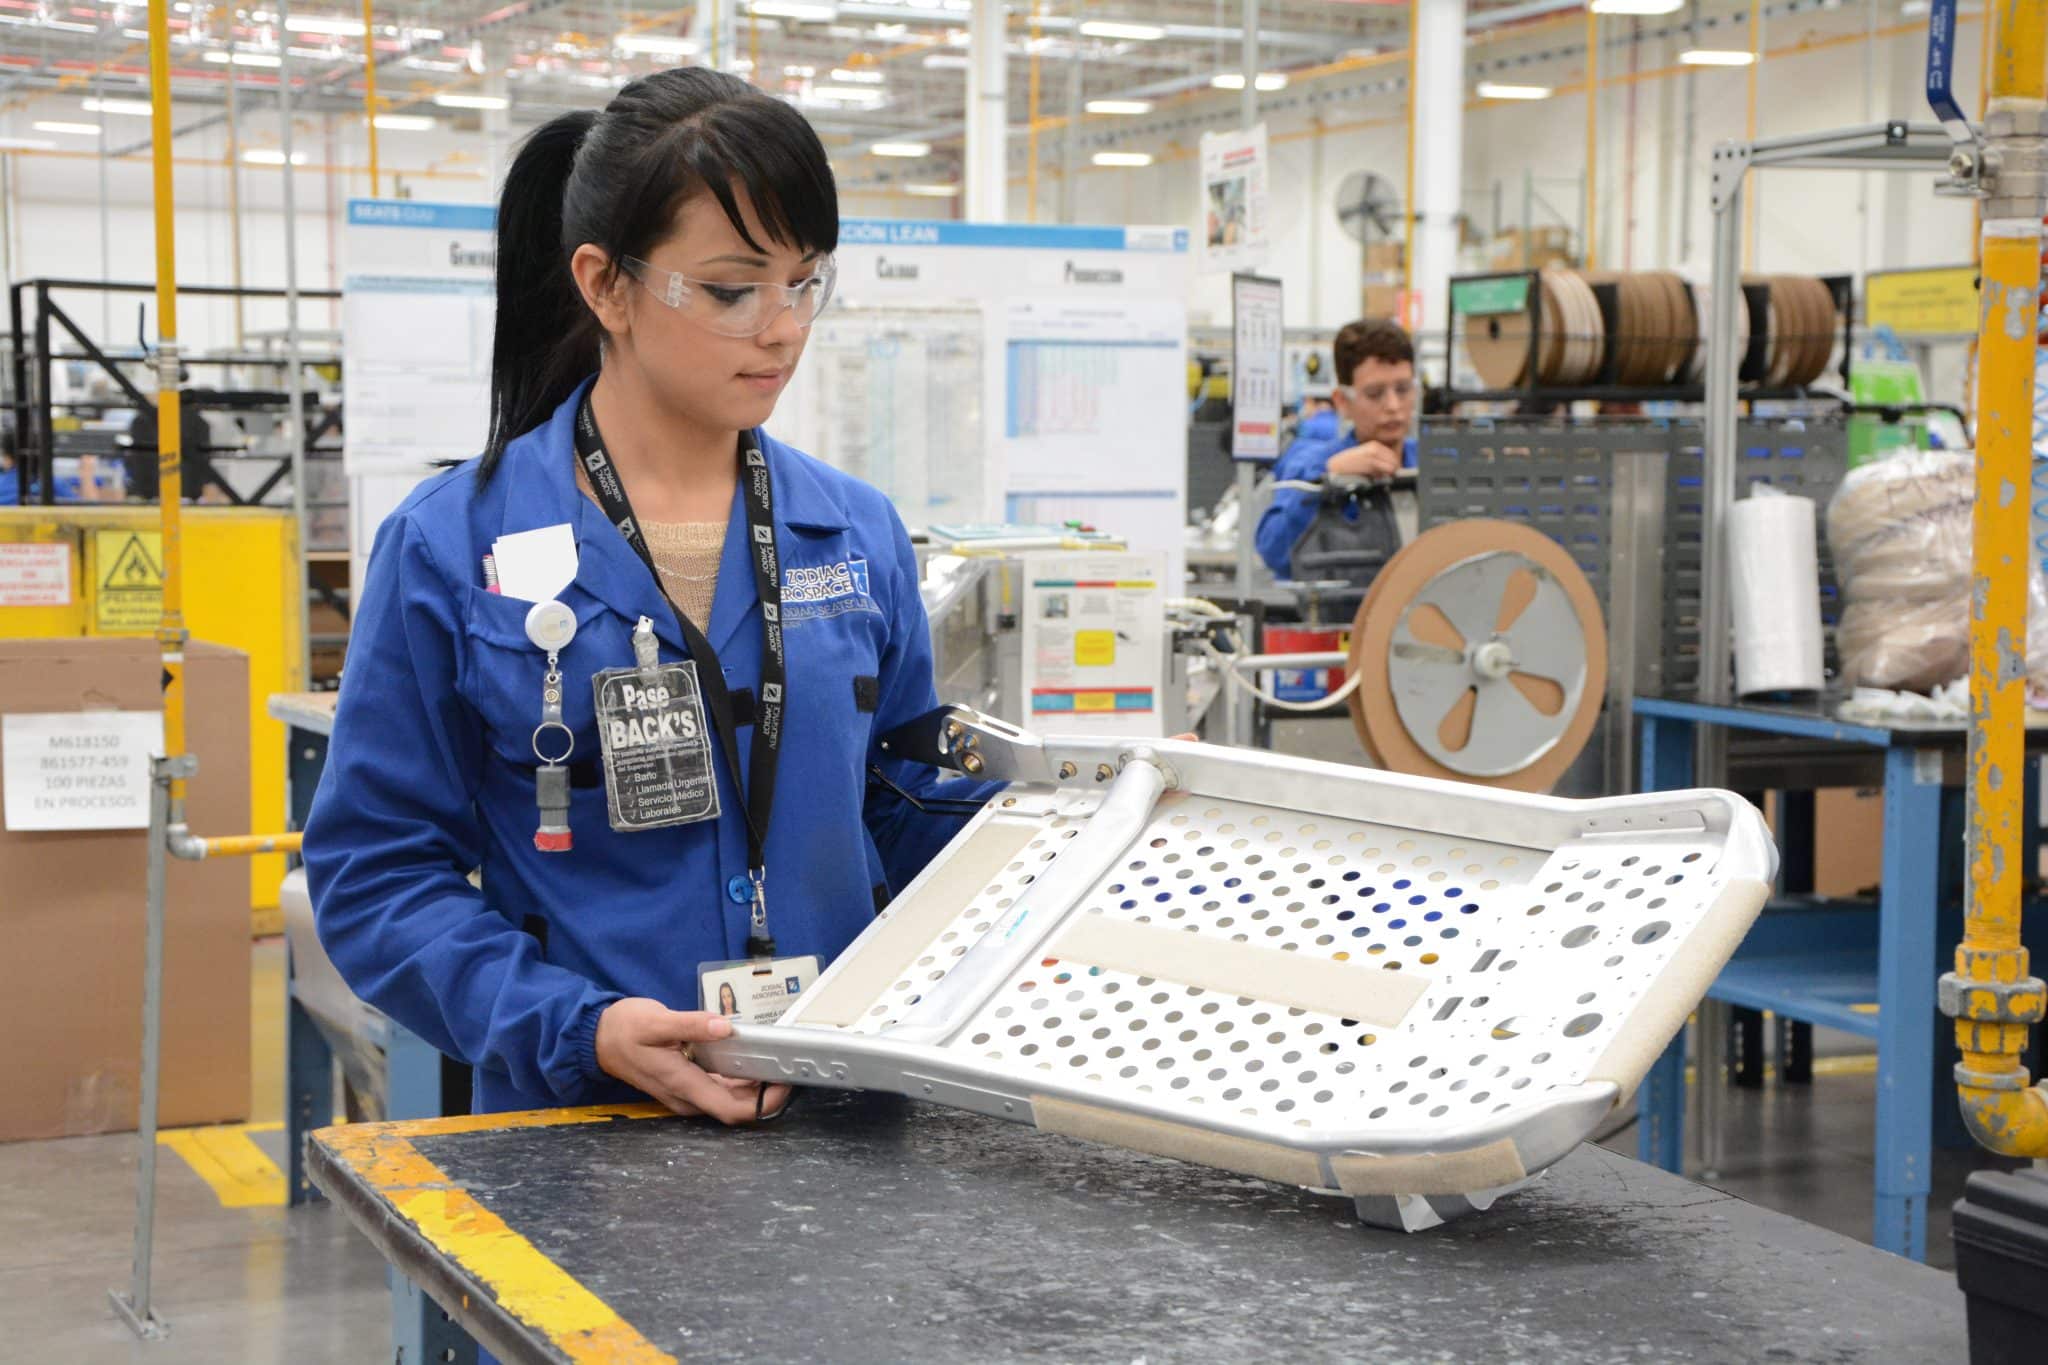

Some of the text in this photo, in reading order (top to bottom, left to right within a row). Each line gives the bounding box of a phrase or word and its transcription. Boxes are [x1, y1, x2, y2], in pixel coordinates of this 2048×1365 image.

[890, 225, 938, 242] LEAN
[752, 468, 761, 496] ZODIAC
[760, 468, 769, 510] AEROSPACE
[760, 545, 769, 575] ZODIAC
[767, 546, 778, 588] AEROSPACE
[785, 562, 850, 586] ZODIAC
[623, 684, 669, 712] Pase
[610, 710, 696, 749] BACK'S
[46, 775, 126, 789] 100 PIEZAS
[636, 781, 673, 795] Llamada
[34, 795, 136, 809] EN PROCESOS
[638, 789, 705, 807] Servicio Médico
[640, 806, 682, 819] Laborales
